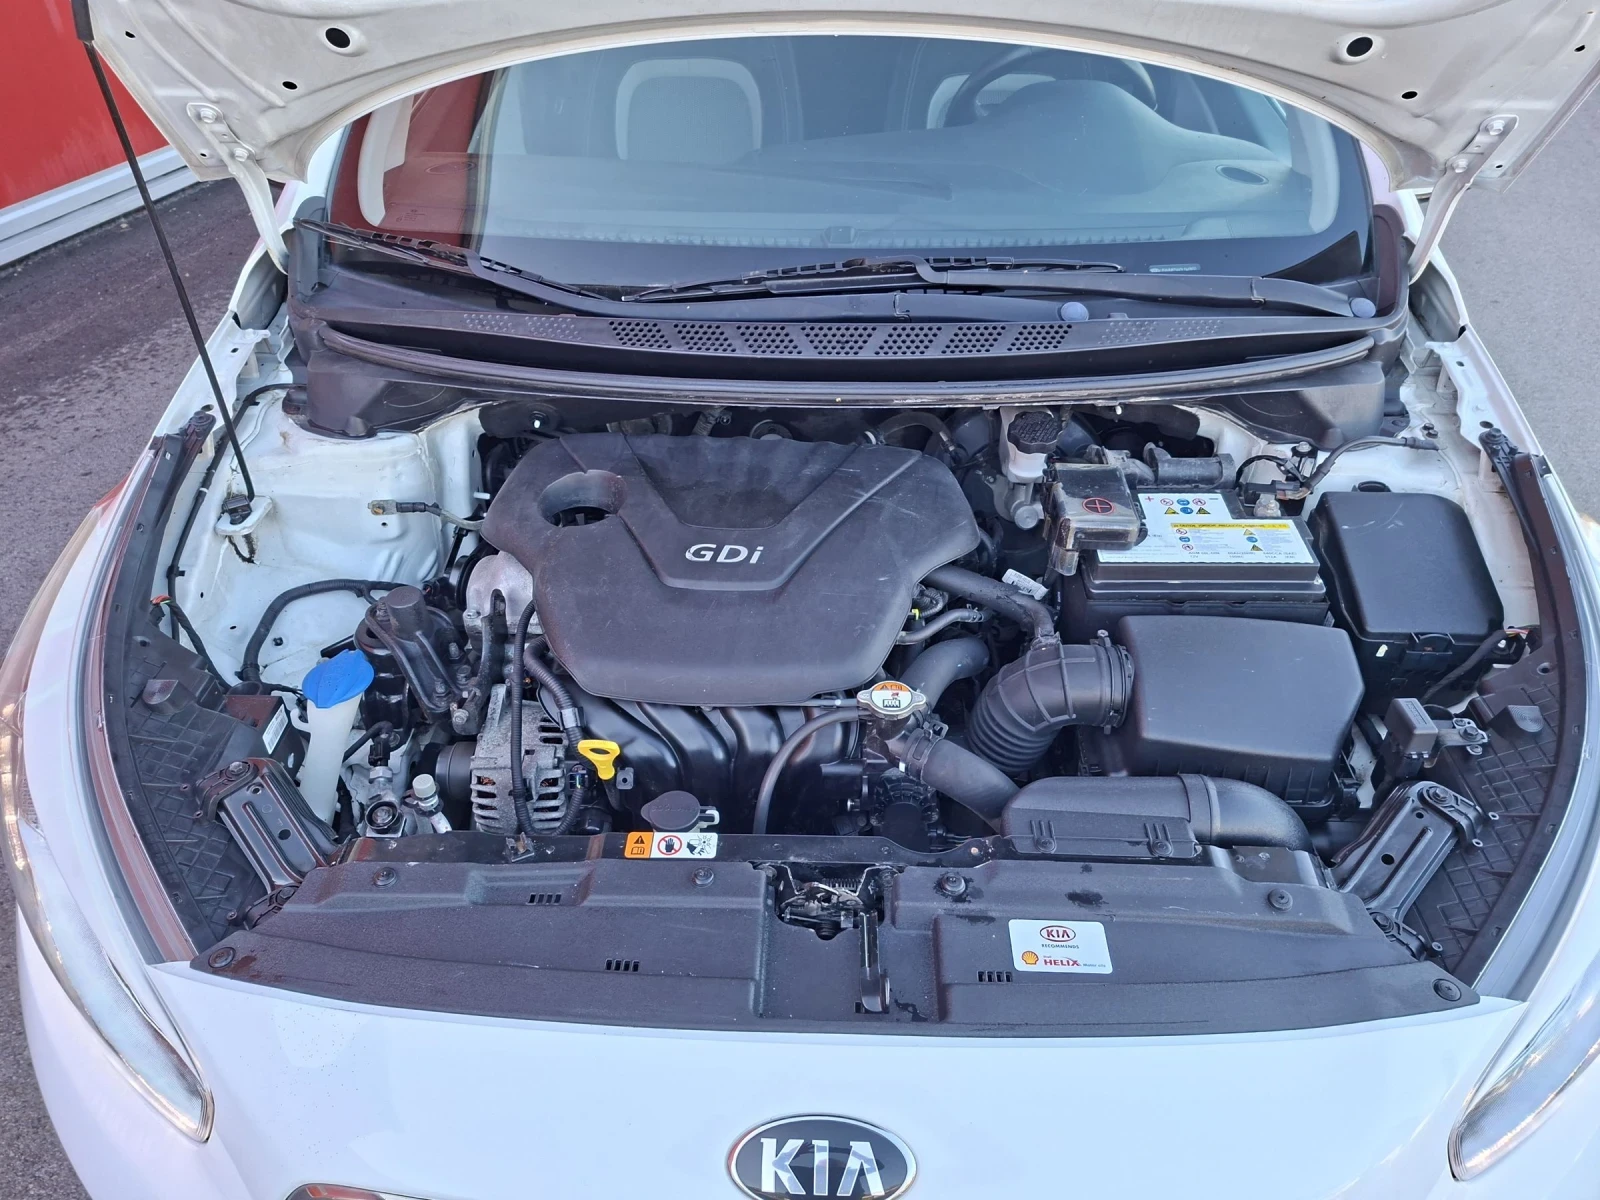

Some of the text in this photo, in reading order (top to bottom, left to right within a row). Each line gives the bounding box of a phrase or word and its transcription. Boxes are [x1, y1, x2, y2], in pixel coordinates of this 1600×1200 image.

[685, 543, 764, 564] GDi
[1046, 929, 1070, 939] KIA
[1043, 959, 1081, 967] HELIX
[760, 1138, 885, 1196] KIA
